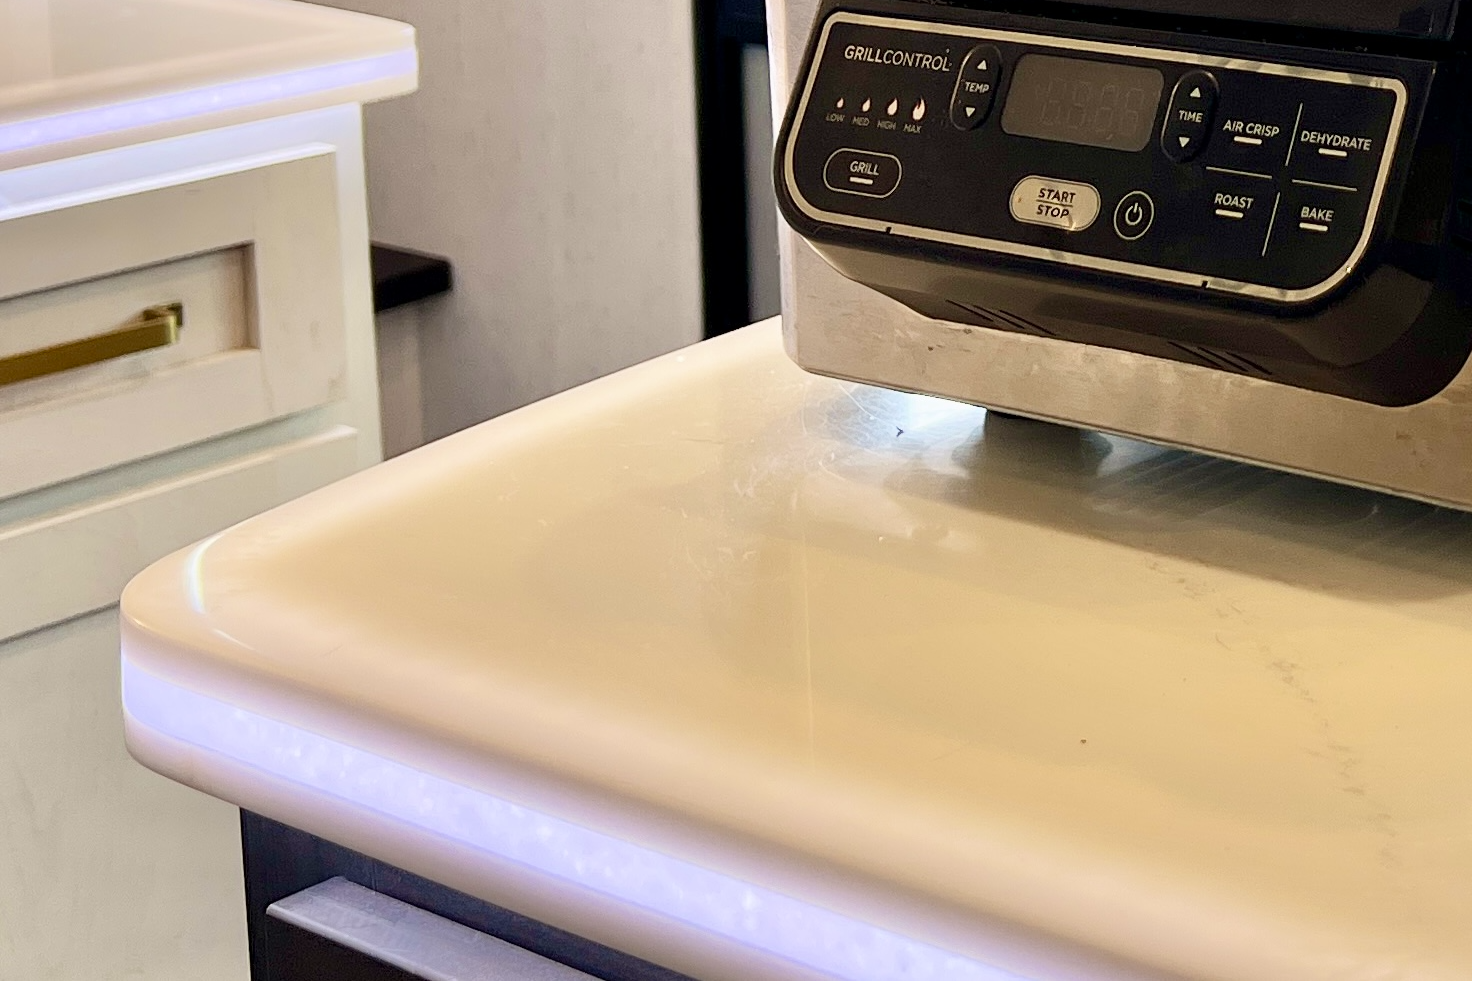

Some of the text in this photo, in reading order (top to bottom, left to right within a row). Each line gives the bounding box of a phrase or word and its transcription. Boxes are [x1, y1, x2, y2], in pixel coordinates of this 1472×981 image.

[965, 81, 990, 94] TEMP
[825, 113, 923, 134] LOW MED HIGH MAX
[1178, 109, 1203, 123] TIME
[1222, 119, 1280, 137] AIR CRISP
[1300, 130, 1373, 151] DEHYDRATE
[849, 160, 880, 176] GRILL
[1038, 187, 1076, 204] START
[1214, 192, 1254, 209] ROAST
[1035, 204, 1070, 220] STOP
[1300, 205, 1334, 222] BAKE
